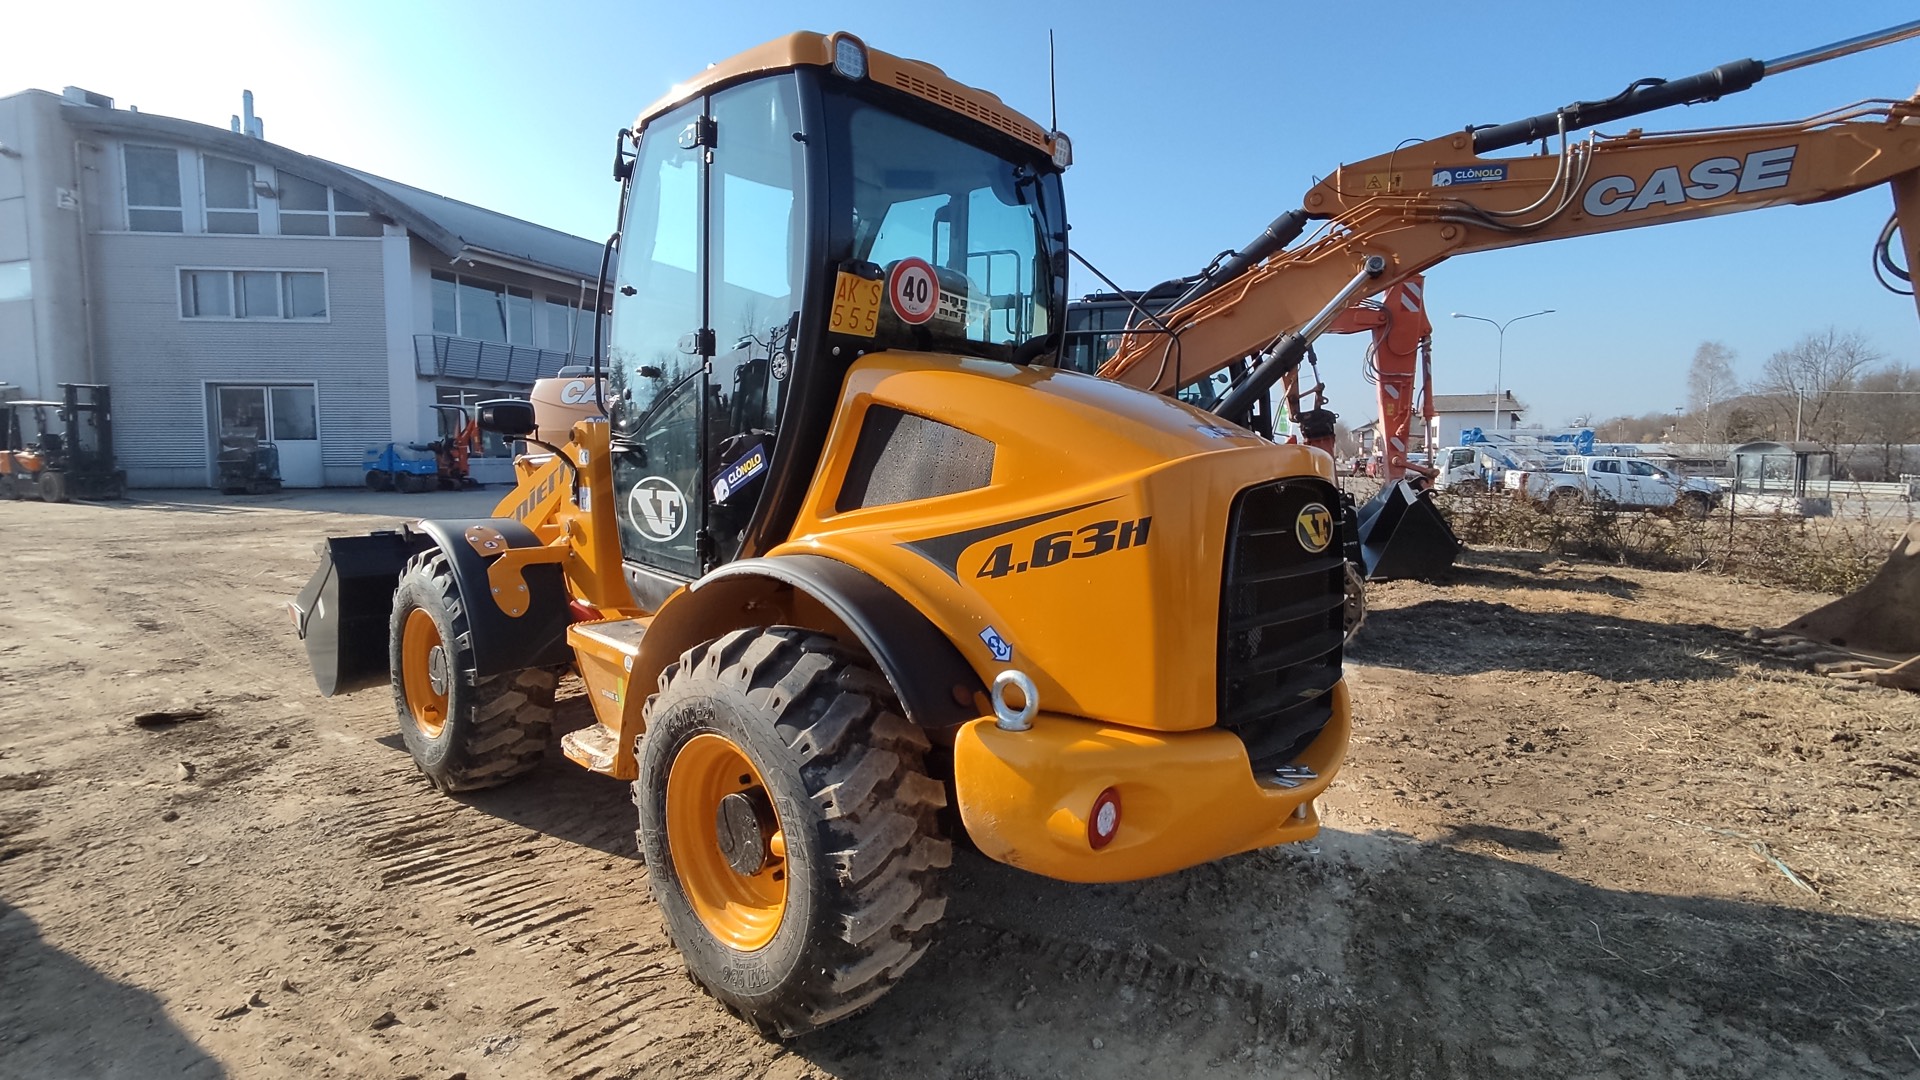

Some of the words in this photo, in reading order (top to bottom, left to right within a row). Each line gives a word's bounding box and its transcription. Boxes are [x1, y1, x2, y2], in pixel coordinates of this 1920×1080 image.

[1455, 168, 1503, 180] CLÒNOLO
[1583, 144, 1799, 217] CASE
[837, 277, 860, 303] AK
[869, 284, 881, 306] S
[903, 275, 928, 304] 40
[832, 304, 876, 332] 555
[728, 453, 762, 485] CLÒNOLO
[976, 516, 1153, 580] 4.63H
